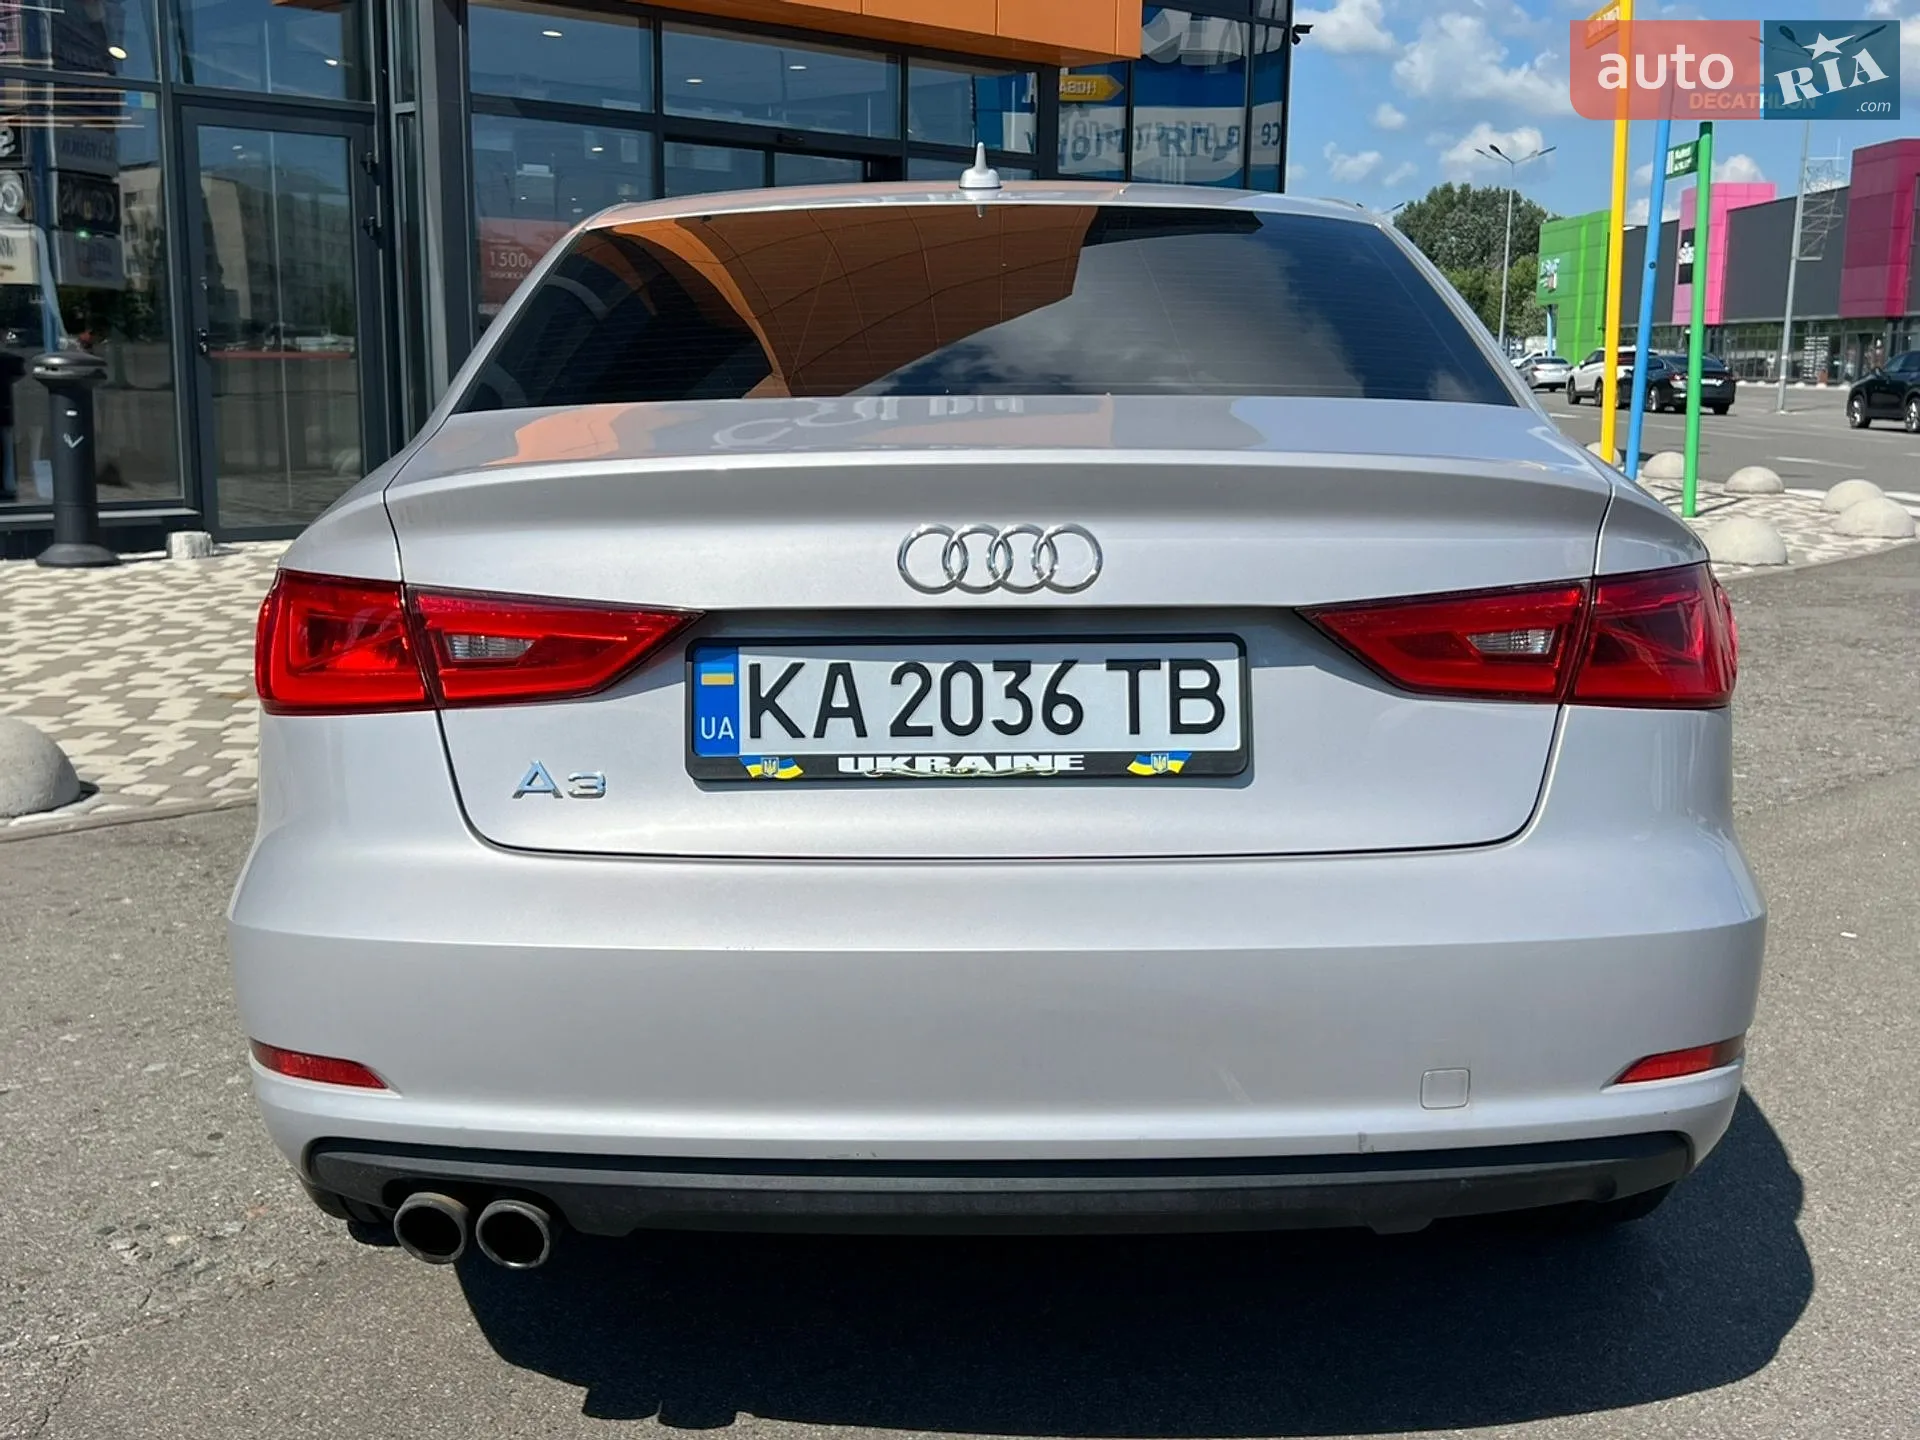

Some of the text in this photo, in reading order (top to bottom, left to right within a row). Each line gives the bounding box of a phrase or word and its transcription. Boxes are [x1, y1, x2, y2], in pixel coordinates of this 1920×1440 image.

[701, 658, 1225, 740] UA KA 2036 TB
[512, 760, 606, 799] A3
[838, 754, 1085, 774] UKRAINE
